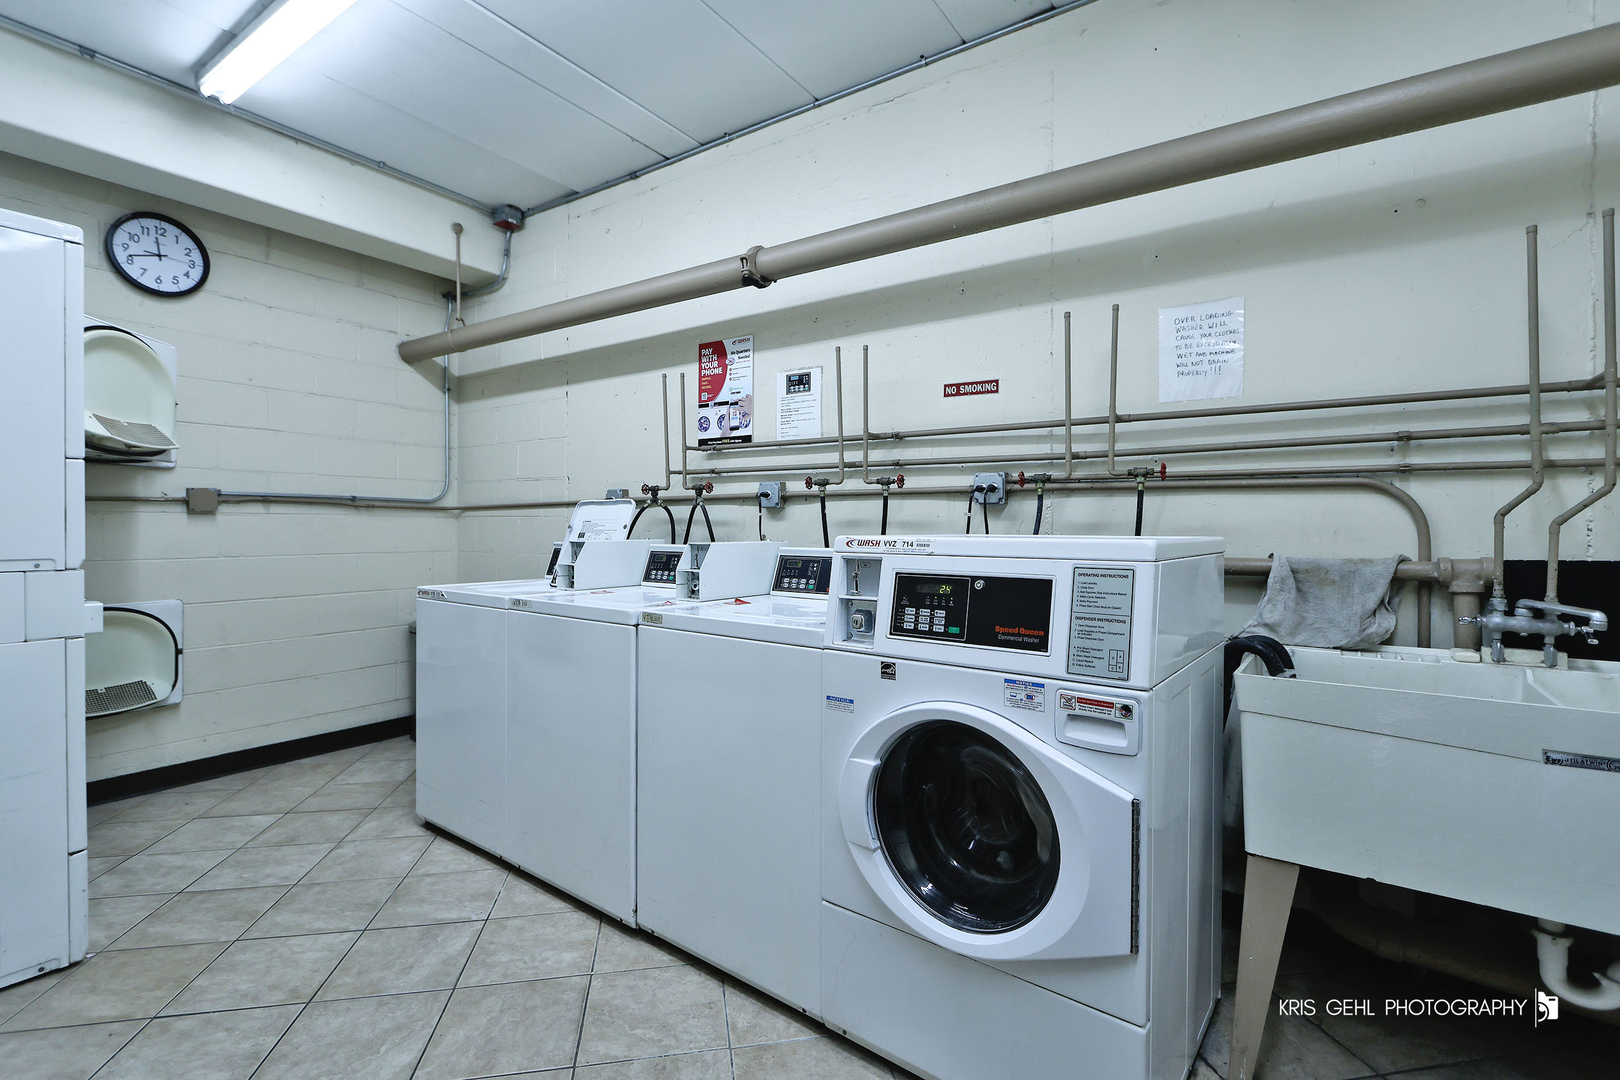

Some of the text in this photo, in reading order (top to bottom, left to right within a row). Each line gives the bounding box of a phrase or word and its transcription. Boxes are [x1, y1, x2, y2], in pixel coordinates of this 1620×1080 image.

[141, 226, 149, 236] 11
[154, 226, 166, 237] 12
[128, 232, 140, 243] 10
[175, 235, 178, 244] 1
[122, 243, 129, 251] 9
[185, 248, 192, 257] 2
[126, 256, 134, 265] 8
[188, 260, 196, 269] 3
[140, 268, 147, 276] 7
[155, 276, 162, 284] 6
[172, 276, 179, 285] 5
[1174, 310, 1234, 325] OVER LOADING
[1175, 321, 1227, 333] WASHER WILL
[1215, 328, 1240, 338] CLOTHES
[702, 348, 713, 356] PAY
[702, 354, 717, 362] WITH
[701, 360, 718, 369] YOUR
[702, 367, 722, 376] PHONE
[946, 382, 996, 394] NO SMOKING
[995, 626, 1044, 636] Speed Queen
